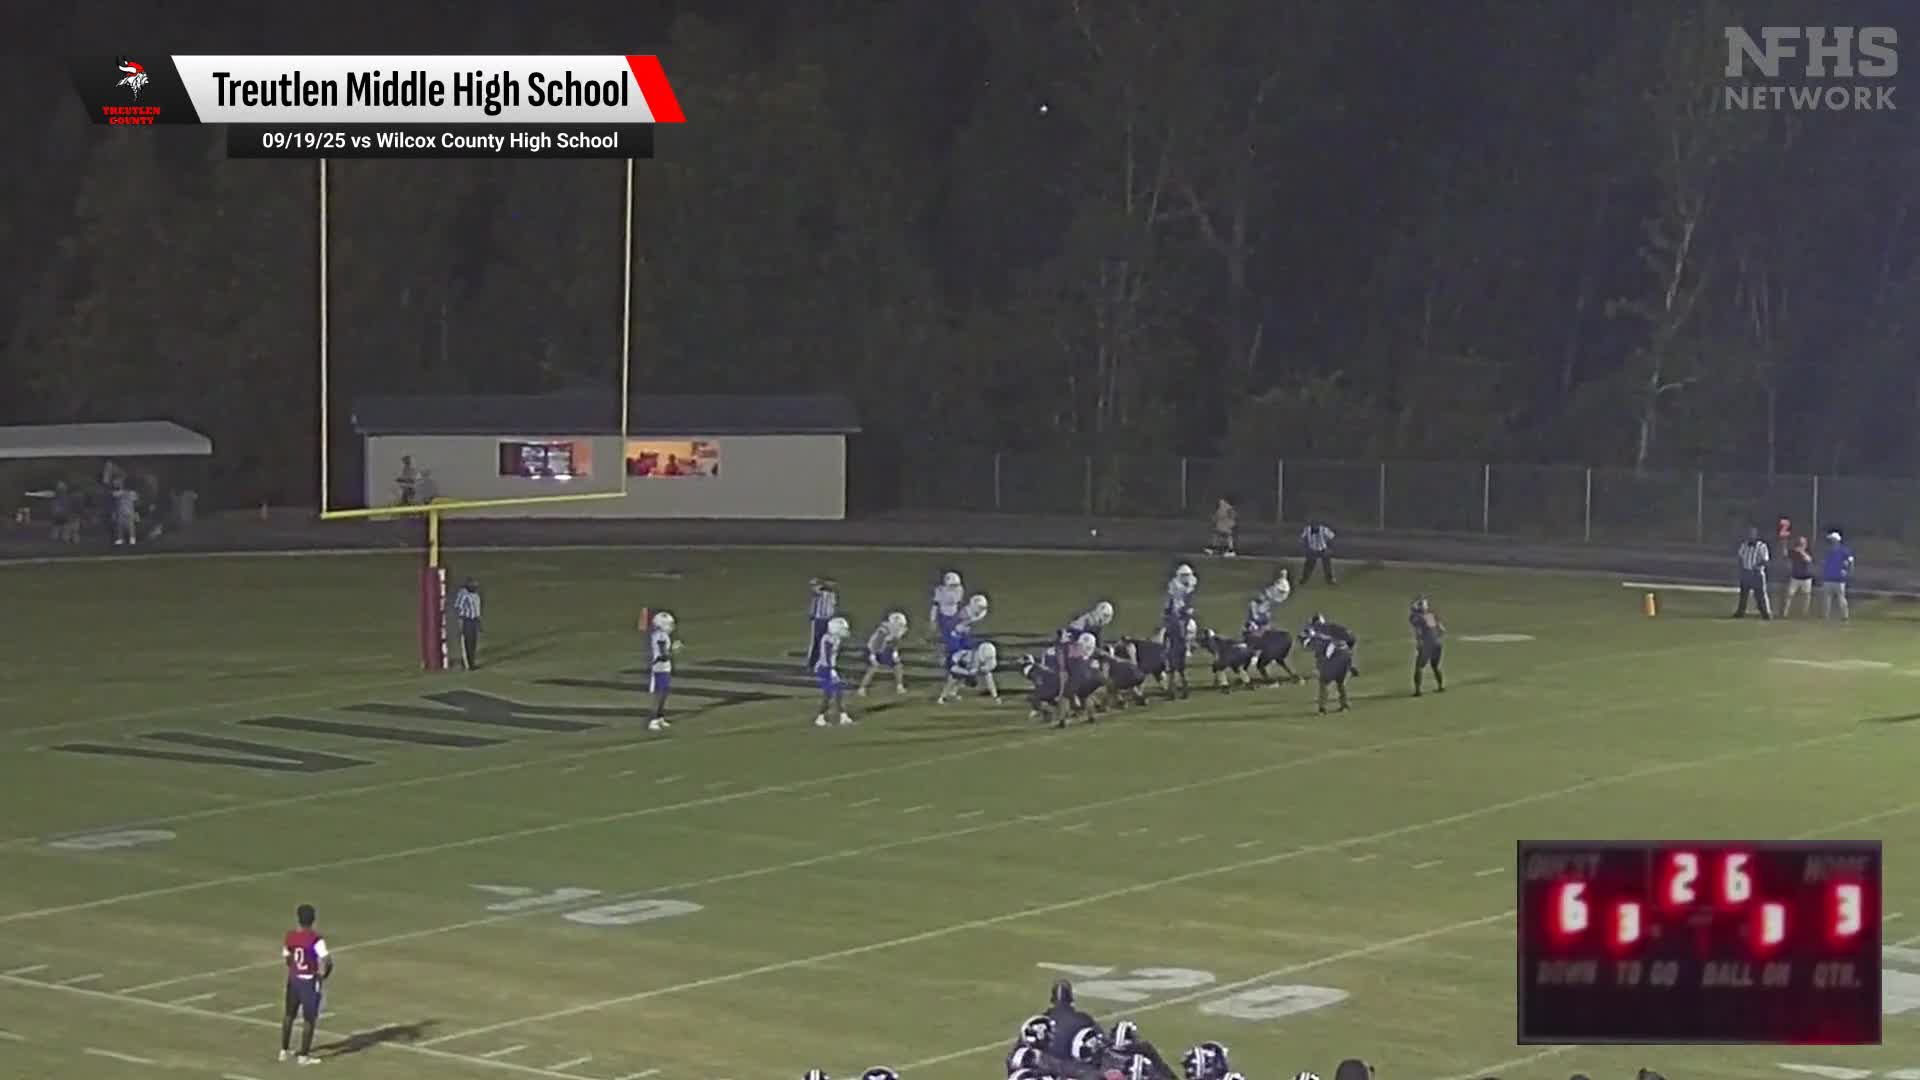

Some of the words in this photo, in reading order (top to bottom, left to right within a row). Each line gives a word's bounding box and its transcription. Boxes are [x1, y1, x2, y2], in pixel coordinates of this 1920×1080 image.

[1560, 881, 1589, 934] 6
[1836, 883, 1863, 936] 3
[1615, 960, 1643, 986] TO
[1702, 960, 1753, 987] BALL
